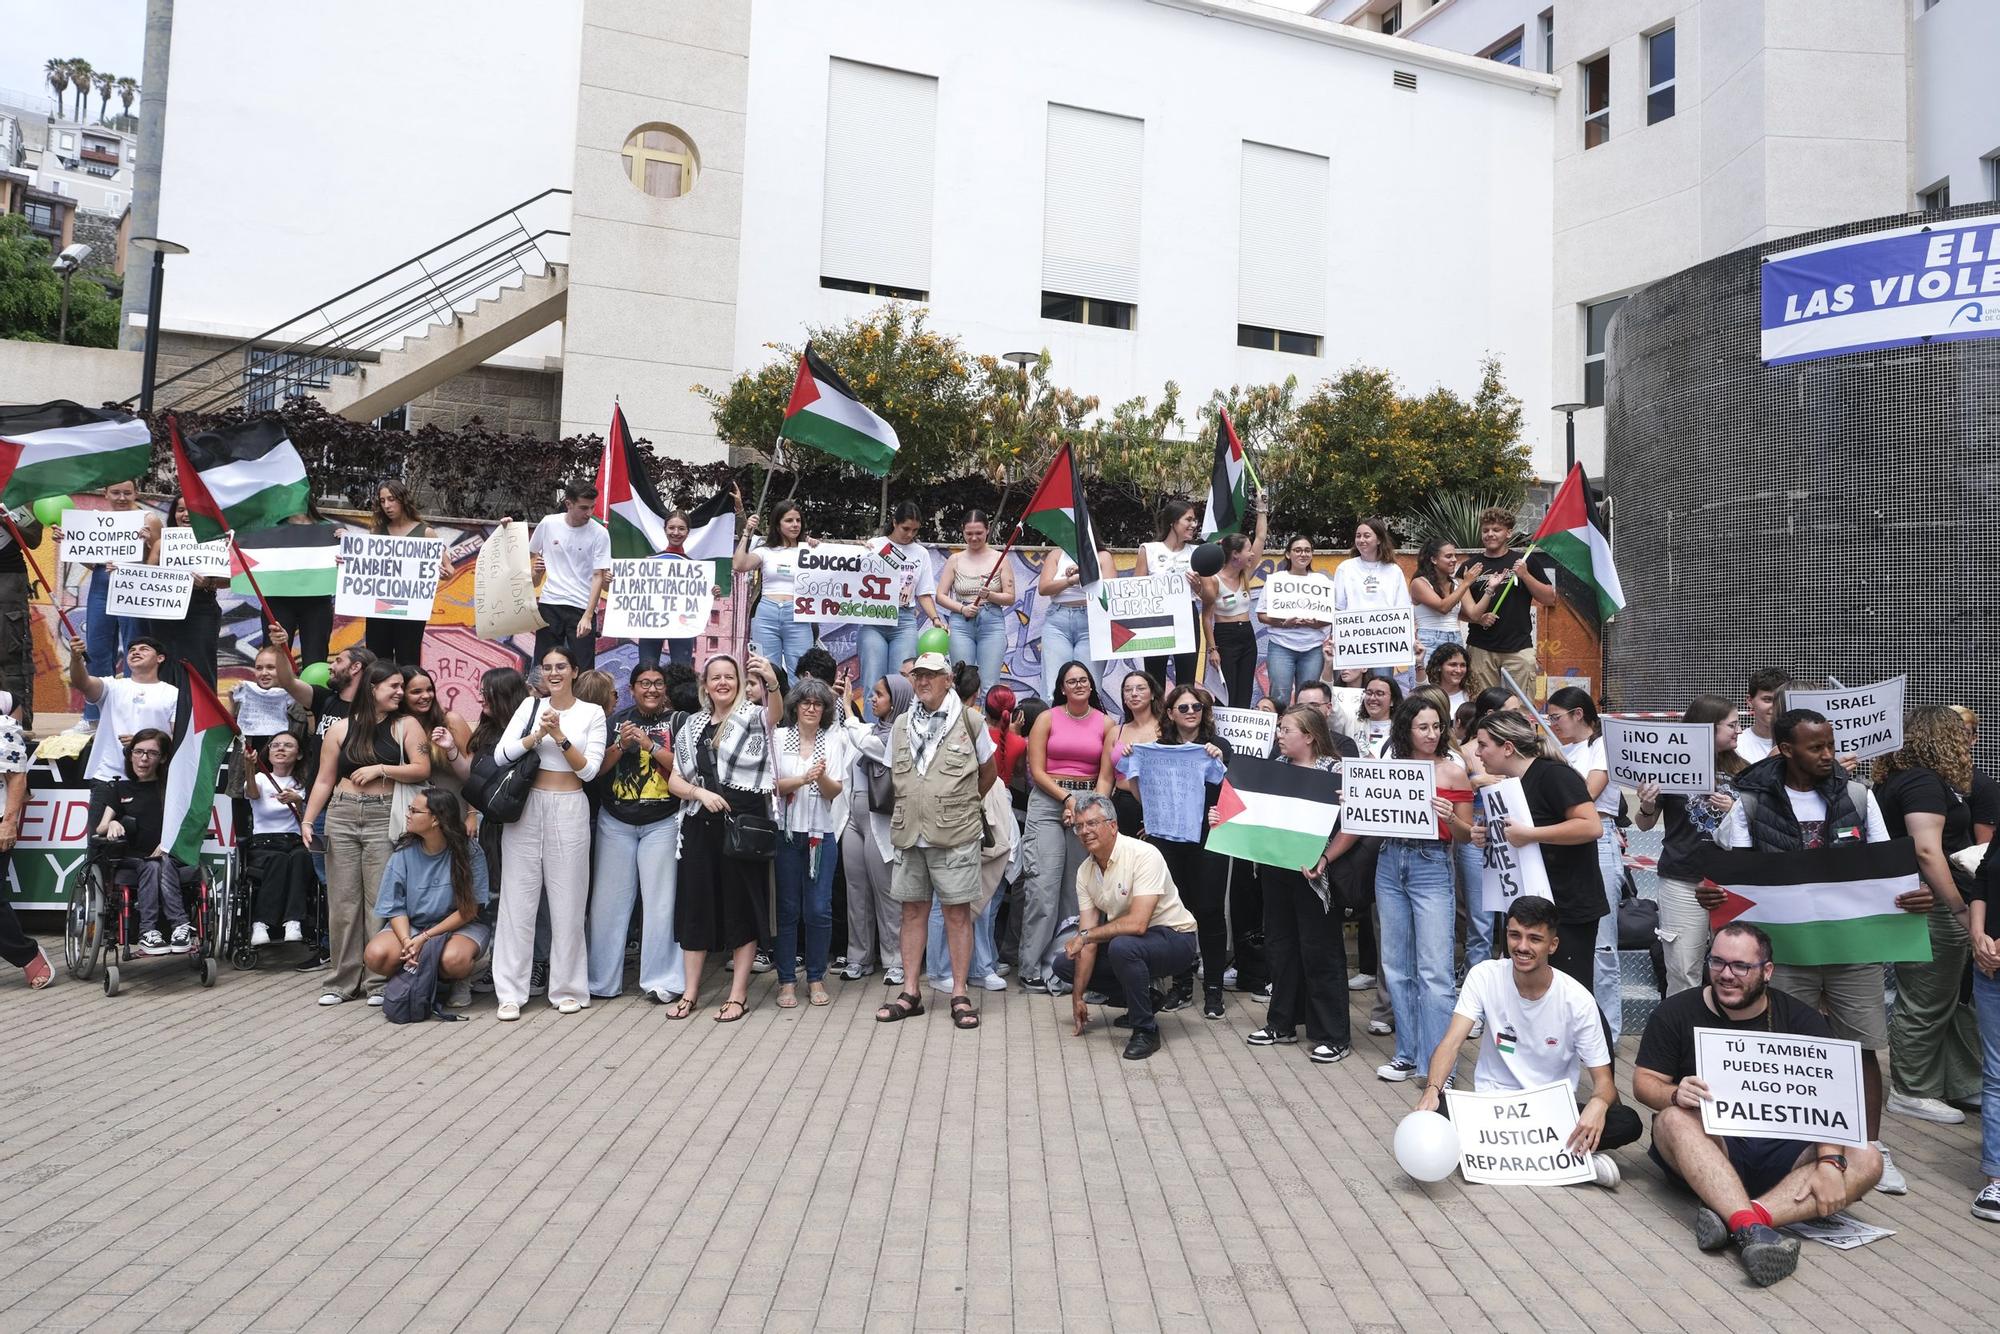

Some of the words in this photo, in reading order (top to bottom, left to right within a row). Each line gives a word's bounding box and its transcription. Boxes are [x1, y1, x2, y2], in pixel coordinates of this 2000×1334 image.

[1784, 284, 1856, 322] LAS
[97, 517, 114, 527] YO
[67, 531, 84, 541] NO
[89, 530, 139, 542] COMPRO
[164, 532, 194, 541] ISRAEL
[68, 545, 136, 556] APARTHEID
[180, 543, 227, 552] POBLACIO
[344, 536, 364, 555] NO
[368, 538, 442, 560] POSICIONARSE
[117, 568, 148, 578] ISRAEL
[151, 571, 190, 581] DERRIBA
[343, 557, 402, 577] TAMBIÉN
[419, 561, 436, 579] ES
[639, 562, 663, 577] QUE
[115, 580, 134, 589] LAS
[140, 583, 173, 592] CASAS
[176, 585, 189, 593] DE
[342, 576, 437, 600] POSICIONARSE
[612, 579, 626, 594] LA
[1274, 582, 1331, 597] BOICOT
[116, 595, 182, 608] PALESTINA
[613, 595, 654, 611] SOCIAL
[662, 595, 678, 611] TE
[685, 598, 699, 613] DA
[794, 597, 815, 615] SE
[1111, 596, 1164, 616] LIBRE
[1335, 615, 1365, 625] ISRAEL
[1369, 613, 1400, 623] ACOSA
[1402, 612, 1410, 620] A
[1339, 629, 1350, 638] LA
[1338, 641, 1409, 656] PALESTINA
[1826, 694, 1876, 711] ISRAEL
[1231, 714, 1270, 727] DERRIBA
[1223, 727, 1253, 739] CASAS
[1255, 731, 1269, 741] DE
[1667, 732, 1688, 745] AL
[1621, 749, 1691, 765] SILENCIO
[1349, 767, 1385, 780] ISRAEL
[1389, 768, 1425, 781] ROBA
[1614, 766, 1702, 785] CÓMPLICE!!
[1349, 786, 1359, 798] EL
[1365, 787, 1402, 800] AGUA
[1409, 789, 1425, 801] DE
[1346, 807, 1430, 826] PALESTINA
[1725, 1038, 1745, 1053] TÚ
[1757, 1042, 1828, 1060] TAMBIÉN
[1723, 1060, 1779, 1075] PUEDES
[1784, 1064, 1834, 1080] HACER
[1741, 1080, 1781, 1094] ALGO
[1786, 1083, 1818, 1097] POR
[1493, 1102, 1531, 1120] PAZ
[1716, 1100, 1849, 1130] PALESTINA
[1479, 1126, 1559, 1146] JUSTICIA
[1465, 1149, 1586, 1172] REPARACIÓN
